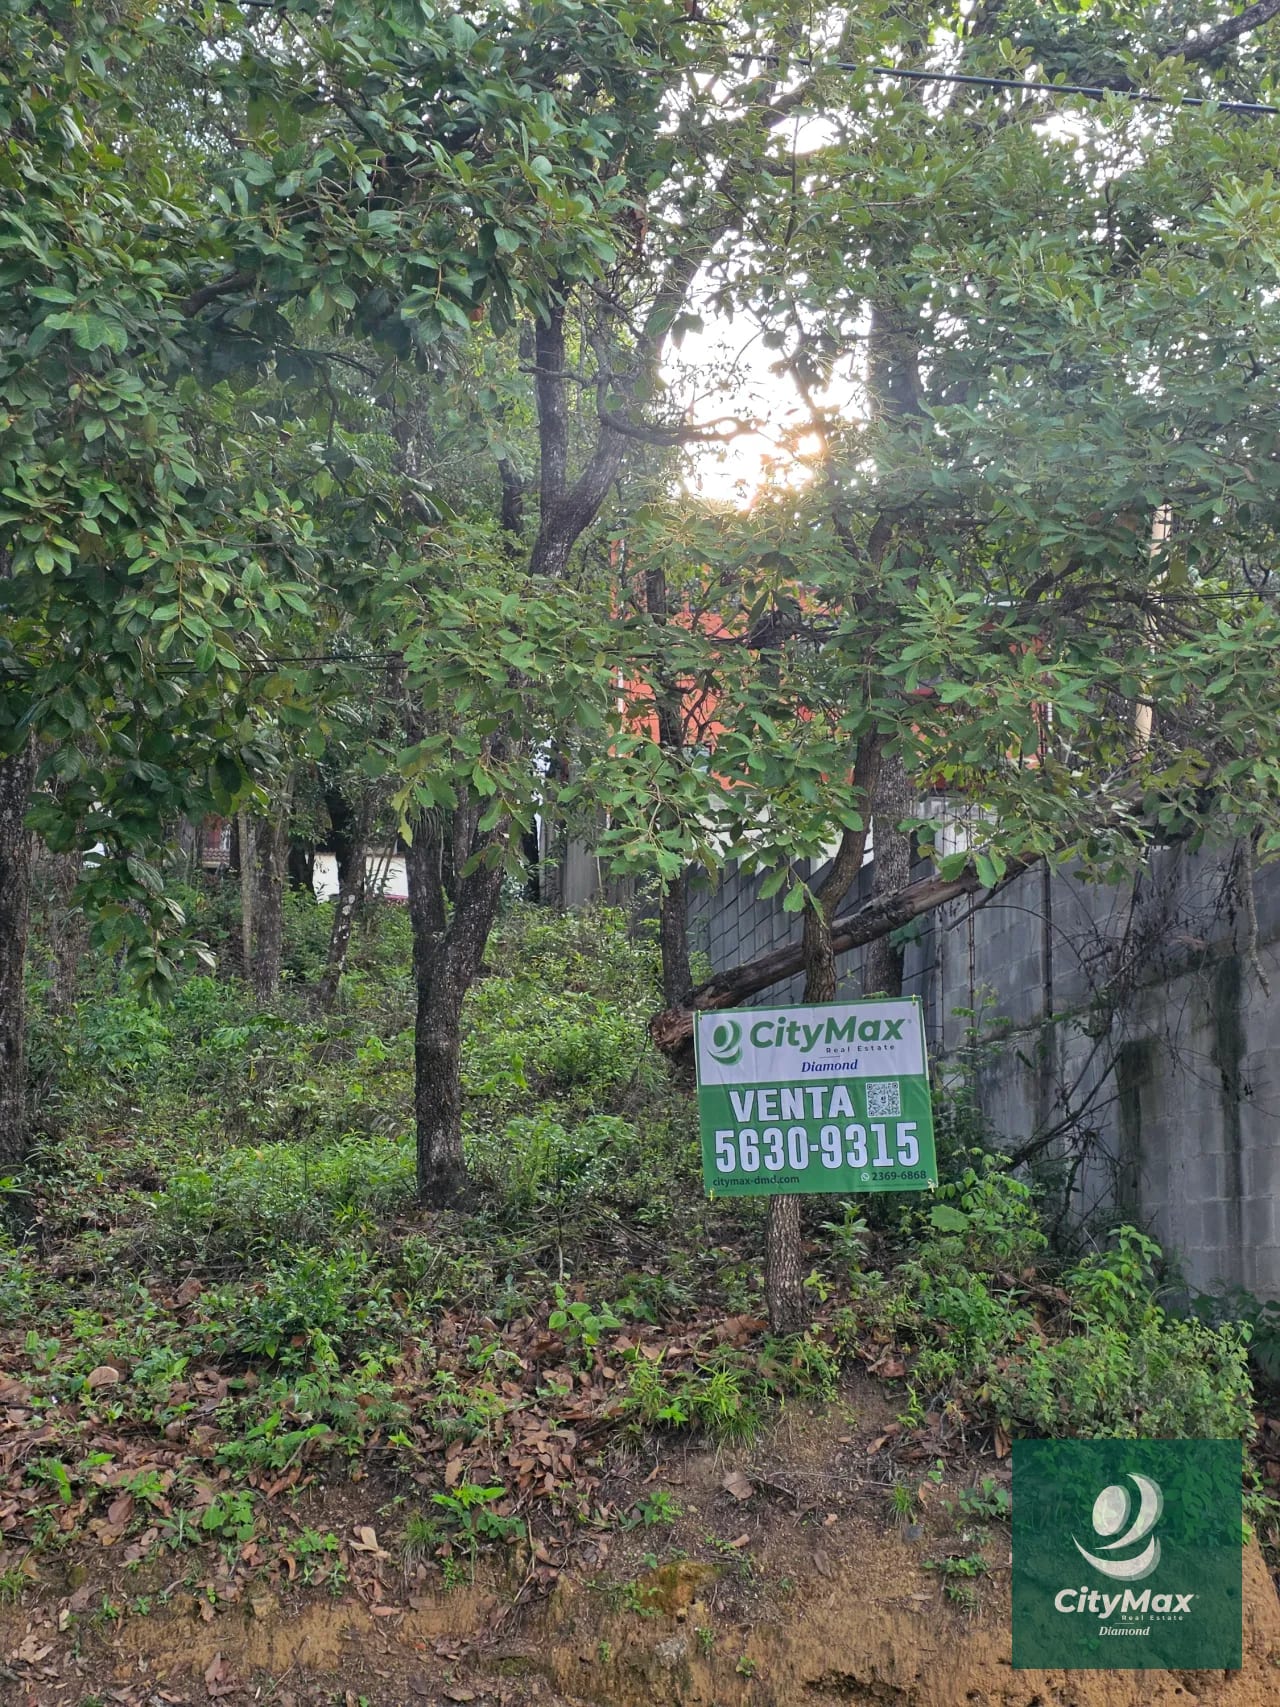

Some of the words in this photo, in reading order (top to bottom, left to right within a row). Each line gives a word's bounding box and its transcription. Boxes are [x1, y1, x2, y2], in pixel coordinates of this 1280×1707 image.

[749, 1015, 906, 1053] CityMax
[857, 1044, 896, 1052] Estate
[801, 1059, 858, 1073] Diamond
[729, 1085, 856, 1123] VENTA
[714, 1122, 920, 1173] 5630-9315
[712, 1174, 800, 1187] citymax-dmd.com
[872, 1170, 927, 1181] 2369-6868
